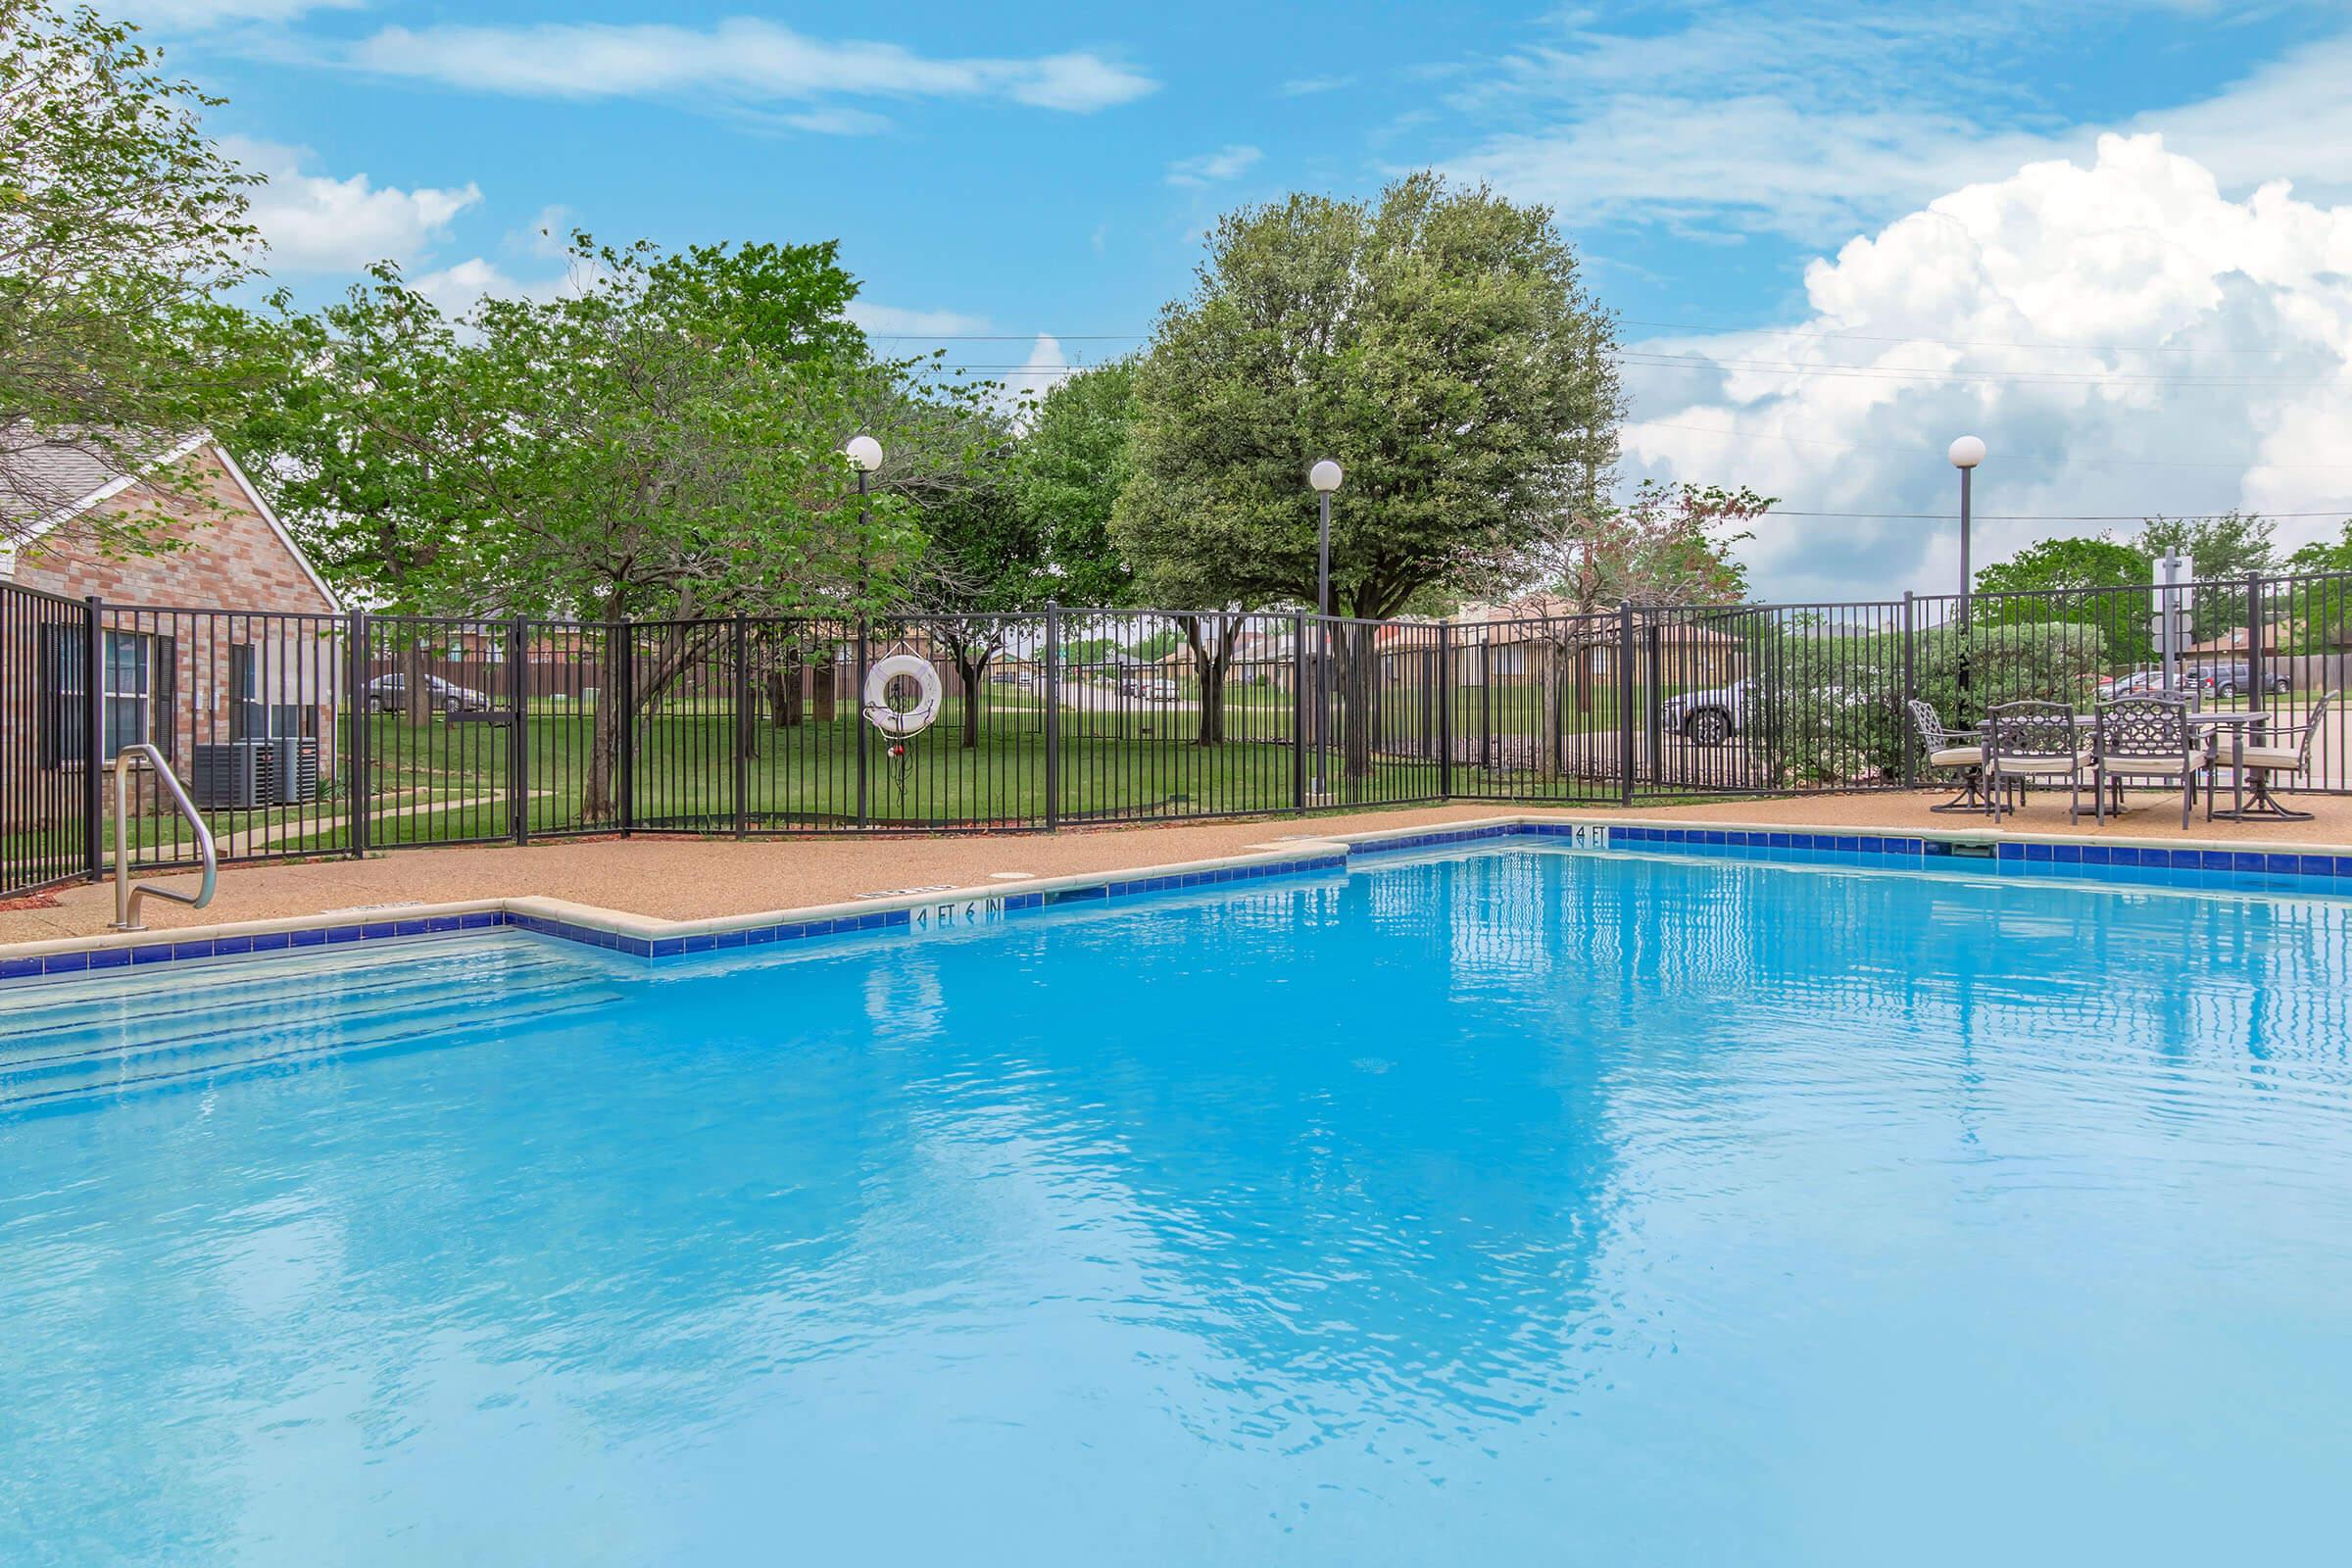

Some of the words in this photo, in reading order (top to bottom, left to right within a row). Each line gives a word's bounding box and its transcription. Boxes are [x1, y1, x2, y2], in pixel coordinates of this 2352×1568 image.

[1576, 825, 1586, 838] 4
[1592, 826, 1605, 840] FT
[917, 908, 927, 922] 4
[938, 904, 956, 920] FT
[965, 902, 975, 916] 6
[986, 898, 1001, 913] IN
